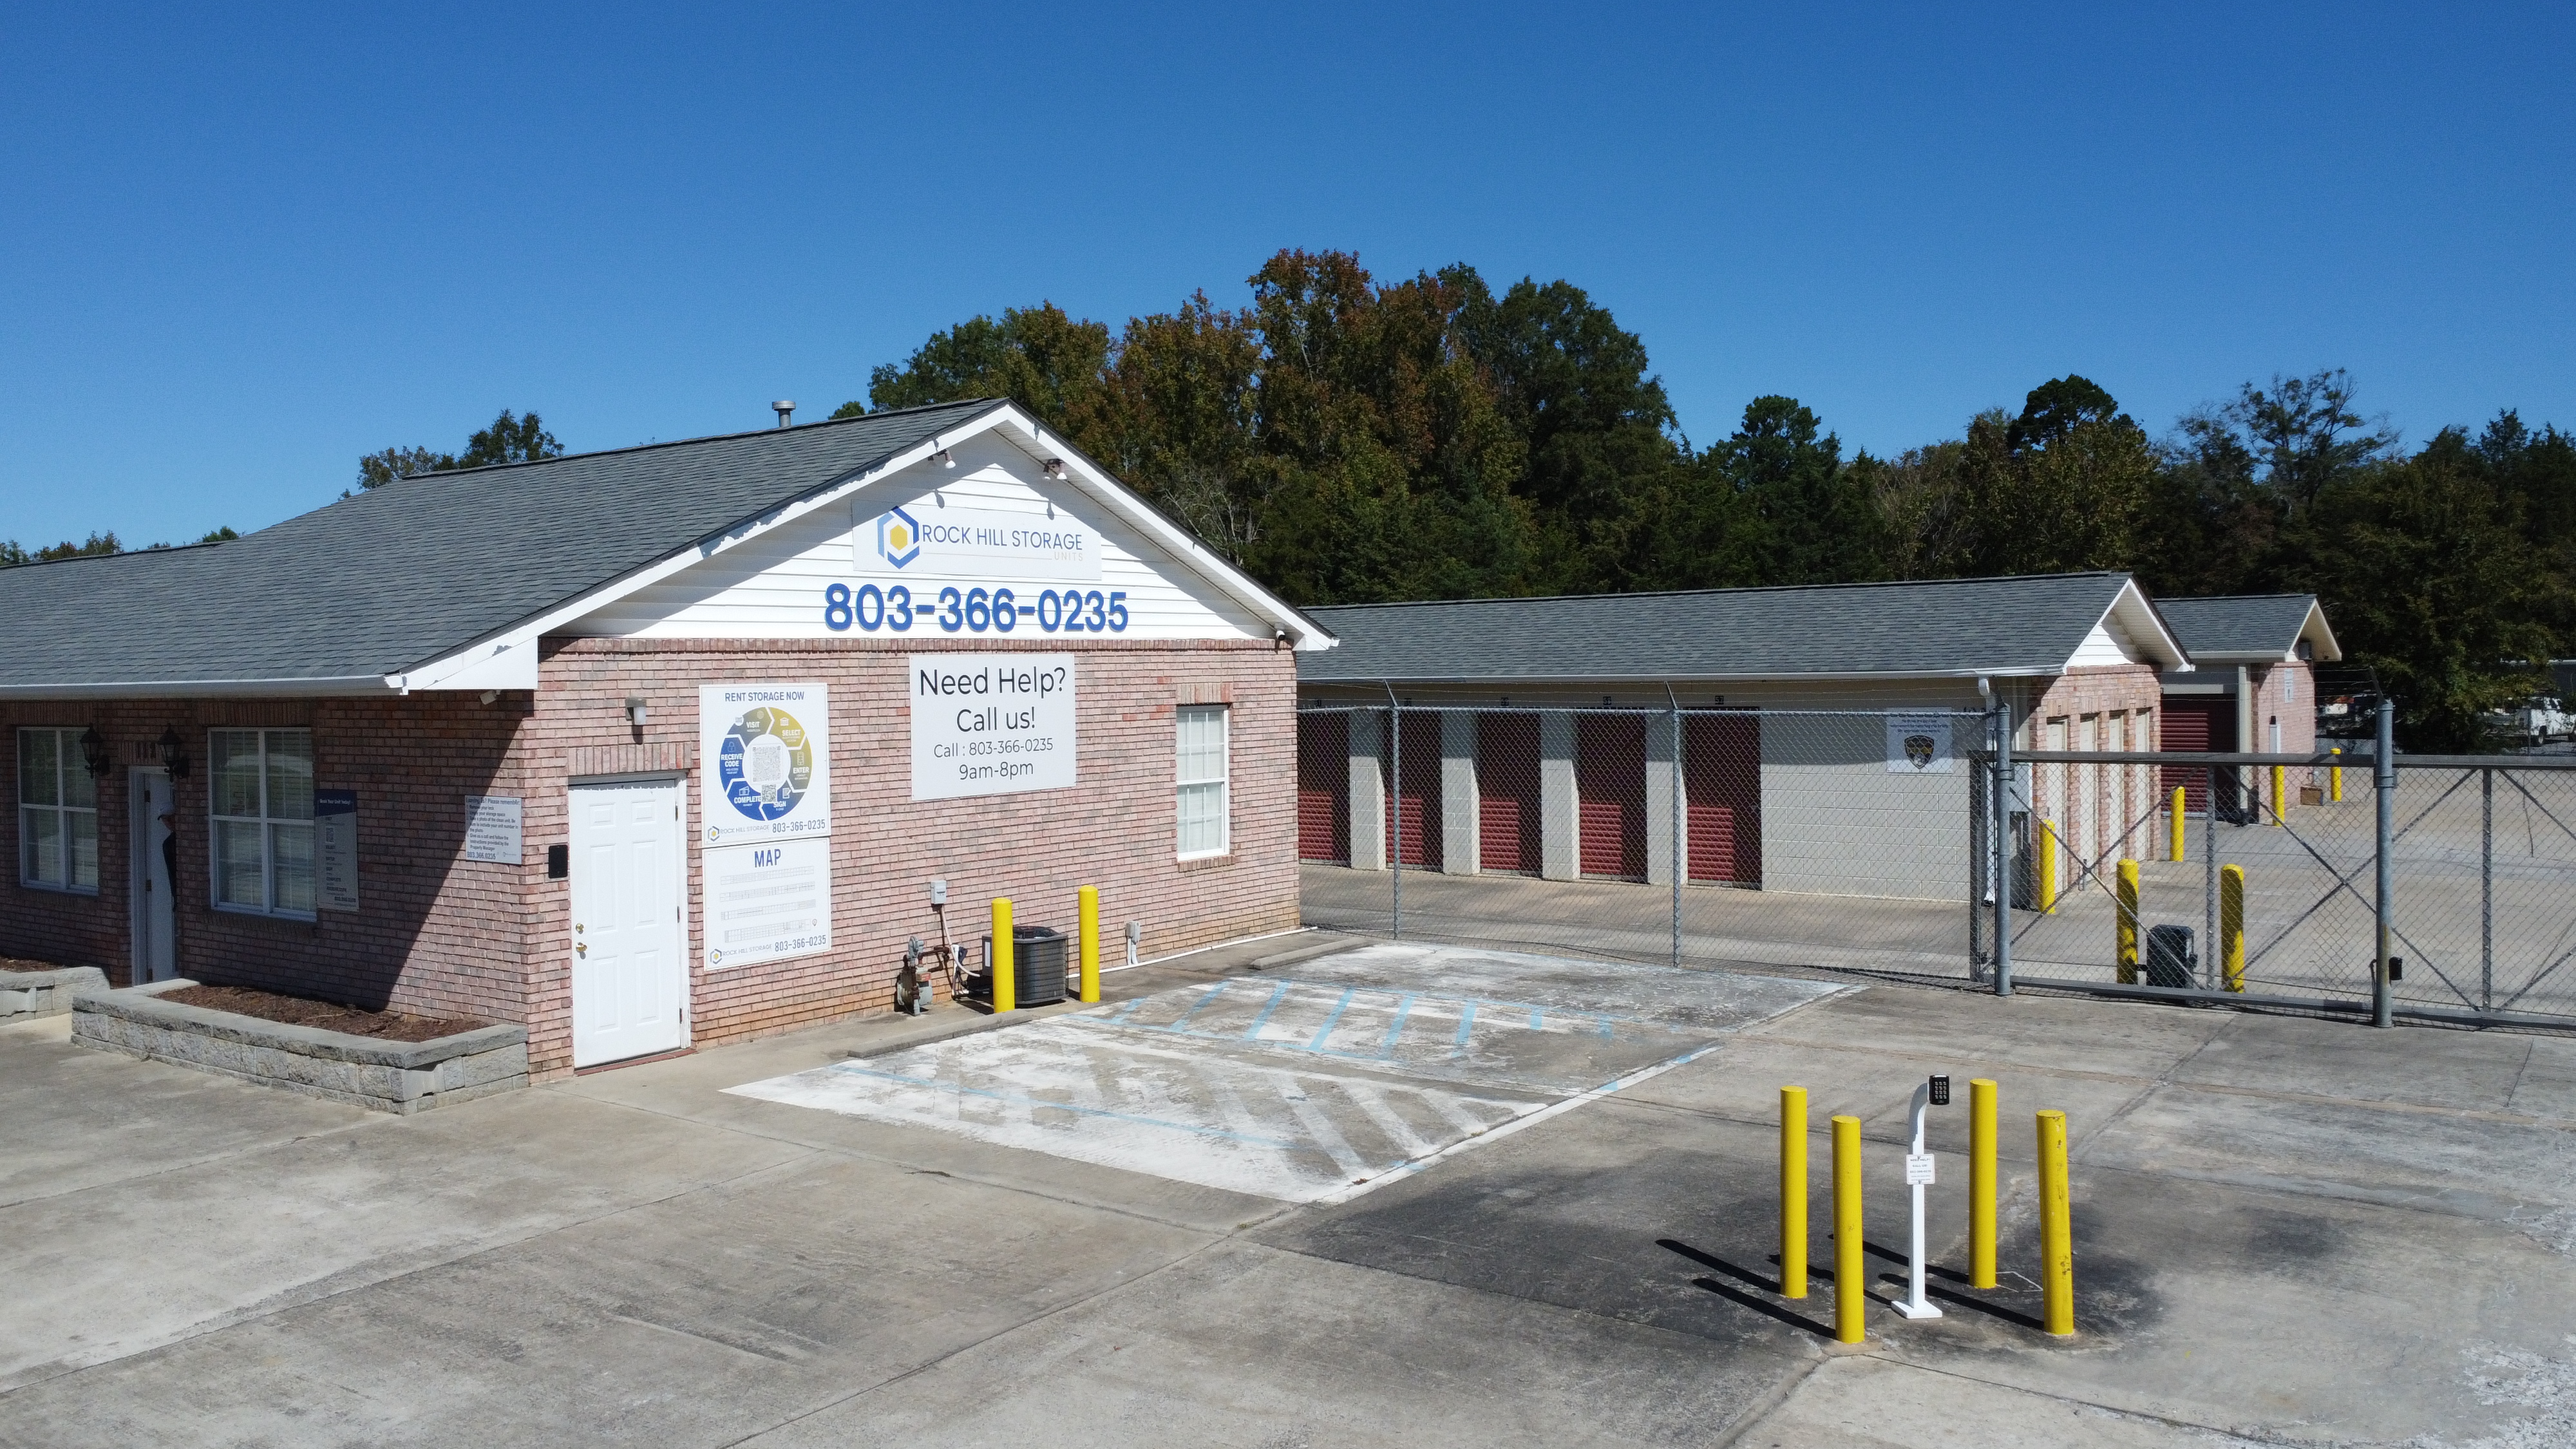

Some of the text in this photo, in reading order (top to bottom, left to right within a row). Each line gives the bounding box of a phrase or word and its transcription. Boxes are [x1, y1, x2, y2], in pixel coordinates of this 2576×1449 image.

[922, 524, 1083, 551] ROCK HILL STORAGE
[1054, 551, 1083, 562] UNITS
[824, 583, 1129, 632] 803-366-0235
[920, 666, 1066, 699] Need Help?
[724, 691, 804, 702] RENT STORAGE NOW
[956, 706, 1036, 732] Call us!
[934, 743, 959, 758] Call
[969, 737, 1054, 756] 803-366-0235
[959, 761, 1034, 781] 9am-8pm
[772, 819, 826, 833] 803-366-0235
[754, 848, 781, 868] MAP
[749, 943, 773, 952] STORAGE
[774, 934, 826, 952] 803-366-0235
